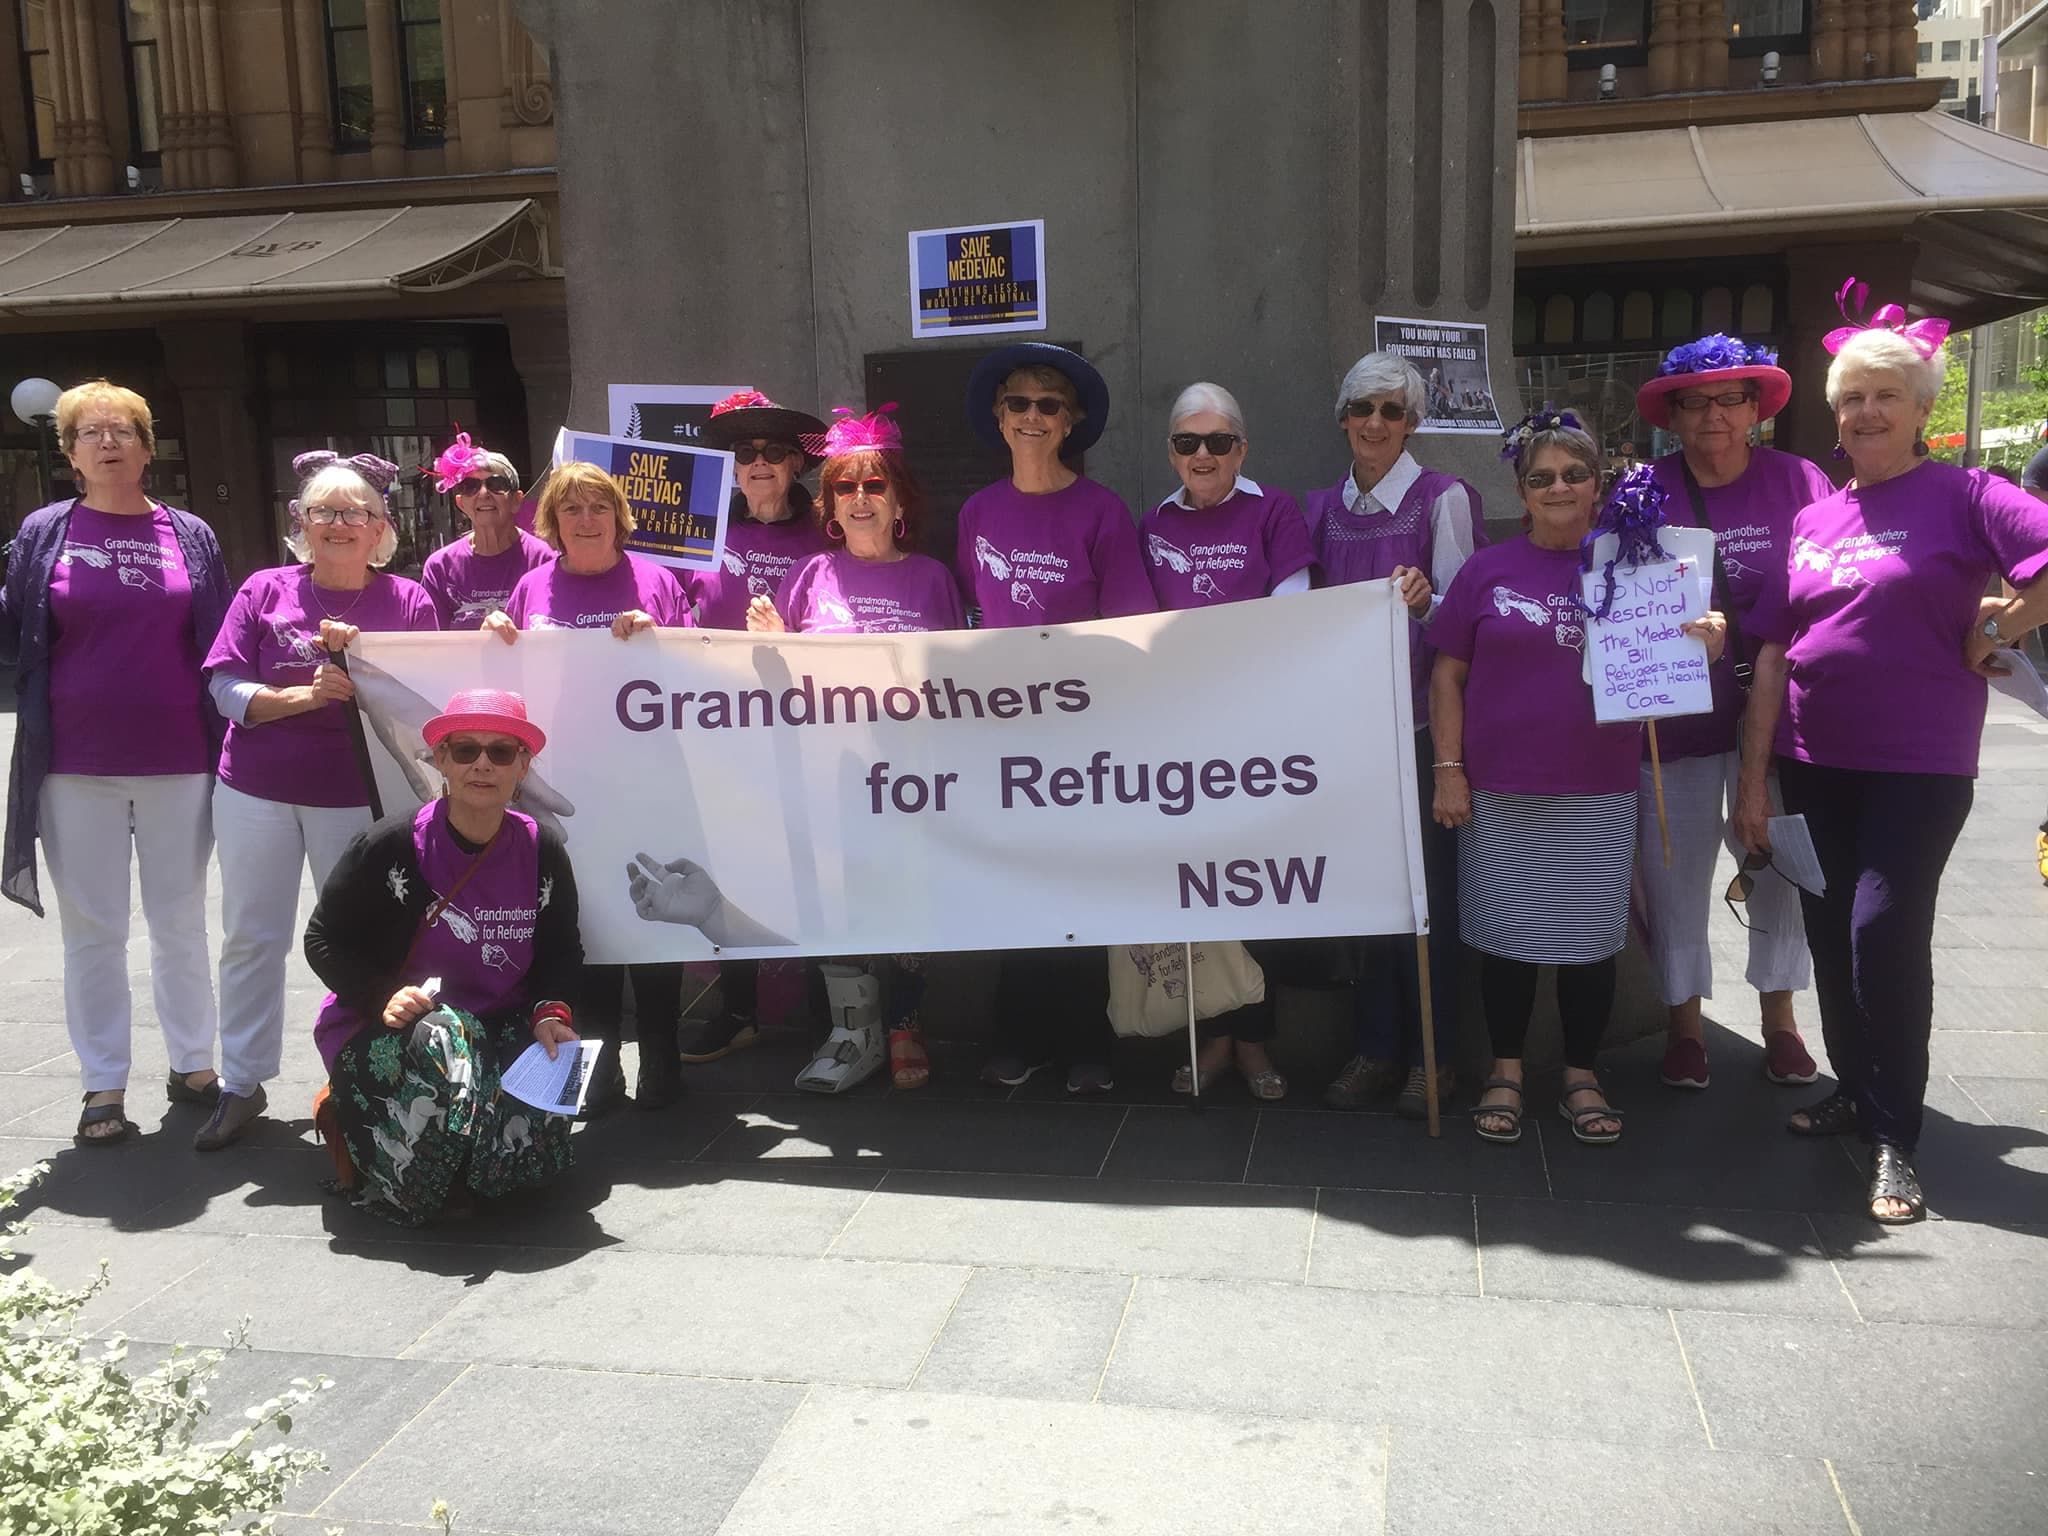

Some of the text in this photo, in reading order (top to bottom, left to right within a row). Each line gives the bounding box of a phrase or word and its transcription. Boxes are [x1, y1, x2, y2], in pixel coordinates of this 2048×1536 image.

[960, 235, 991, 259] SAVE
[948, 256, 1005, 281] MEDEVAC
[938, 282, 1018, 299] ANYTHING LESS
[926, 291, 1031, 309] WOULD BE CRIMINAL
[1400, 327, 1461, 343] YOU KNOW YOUR
[1385, 343, 1476, 361] GOVERNMENT HAS FAILED
[629, 452, 669, 479] SAVE
[612, 474, 682, 506] MEDEVAC
[664, 511, 693, 525] LESS
[647, 520, 708, 539] CRIMINAL
[1711, 524, 1770, 541] andmothers
[104, 537, 175, 558] Grandmothers
[1717, 538, 1773, 557] or Refugees
[1834, 528, 1909, 550] Grandmothers
[745, 549, 798, 565] Grandmoth
[1189, 542, 1247, 556] Grandmothers
[1838, 551, 1854, 565] for
[117, 551, 178, 570] for Refugees
[1010, 548, 1069, 569] Grandmothers
[1195, 556, 1244, 571] for Refugees
[750, 563, 764, 575] for
[1014, 565, 1065, 584] for Refugees
[1634, 574, 1679, 599] Not
[848, 595, 900, 608] Grandmothers
[857, 604, 921, 618] against Detention
[1557, 607, 1572, 622] for
[887, 622, 896, 632] of
[1635, 622, 1686, 646] Medev
[1627, 647, 1654, 665] Bill
[1604, 655, 1705, 682] Refugees need
[1605, 672, 1708, 697] decent Health
[615, 675, 1092, 732] Grandmothers
[1626, 692, 1676, 710] Care
[866, 751, 1318, 816] for Refugees
[1177, 855, 1327, 909] NSW
[473, 905, 537, 922] Grandmothers
[482, 924, 536, 943] for Refugee
[1158, 962, 1172, 977] for
